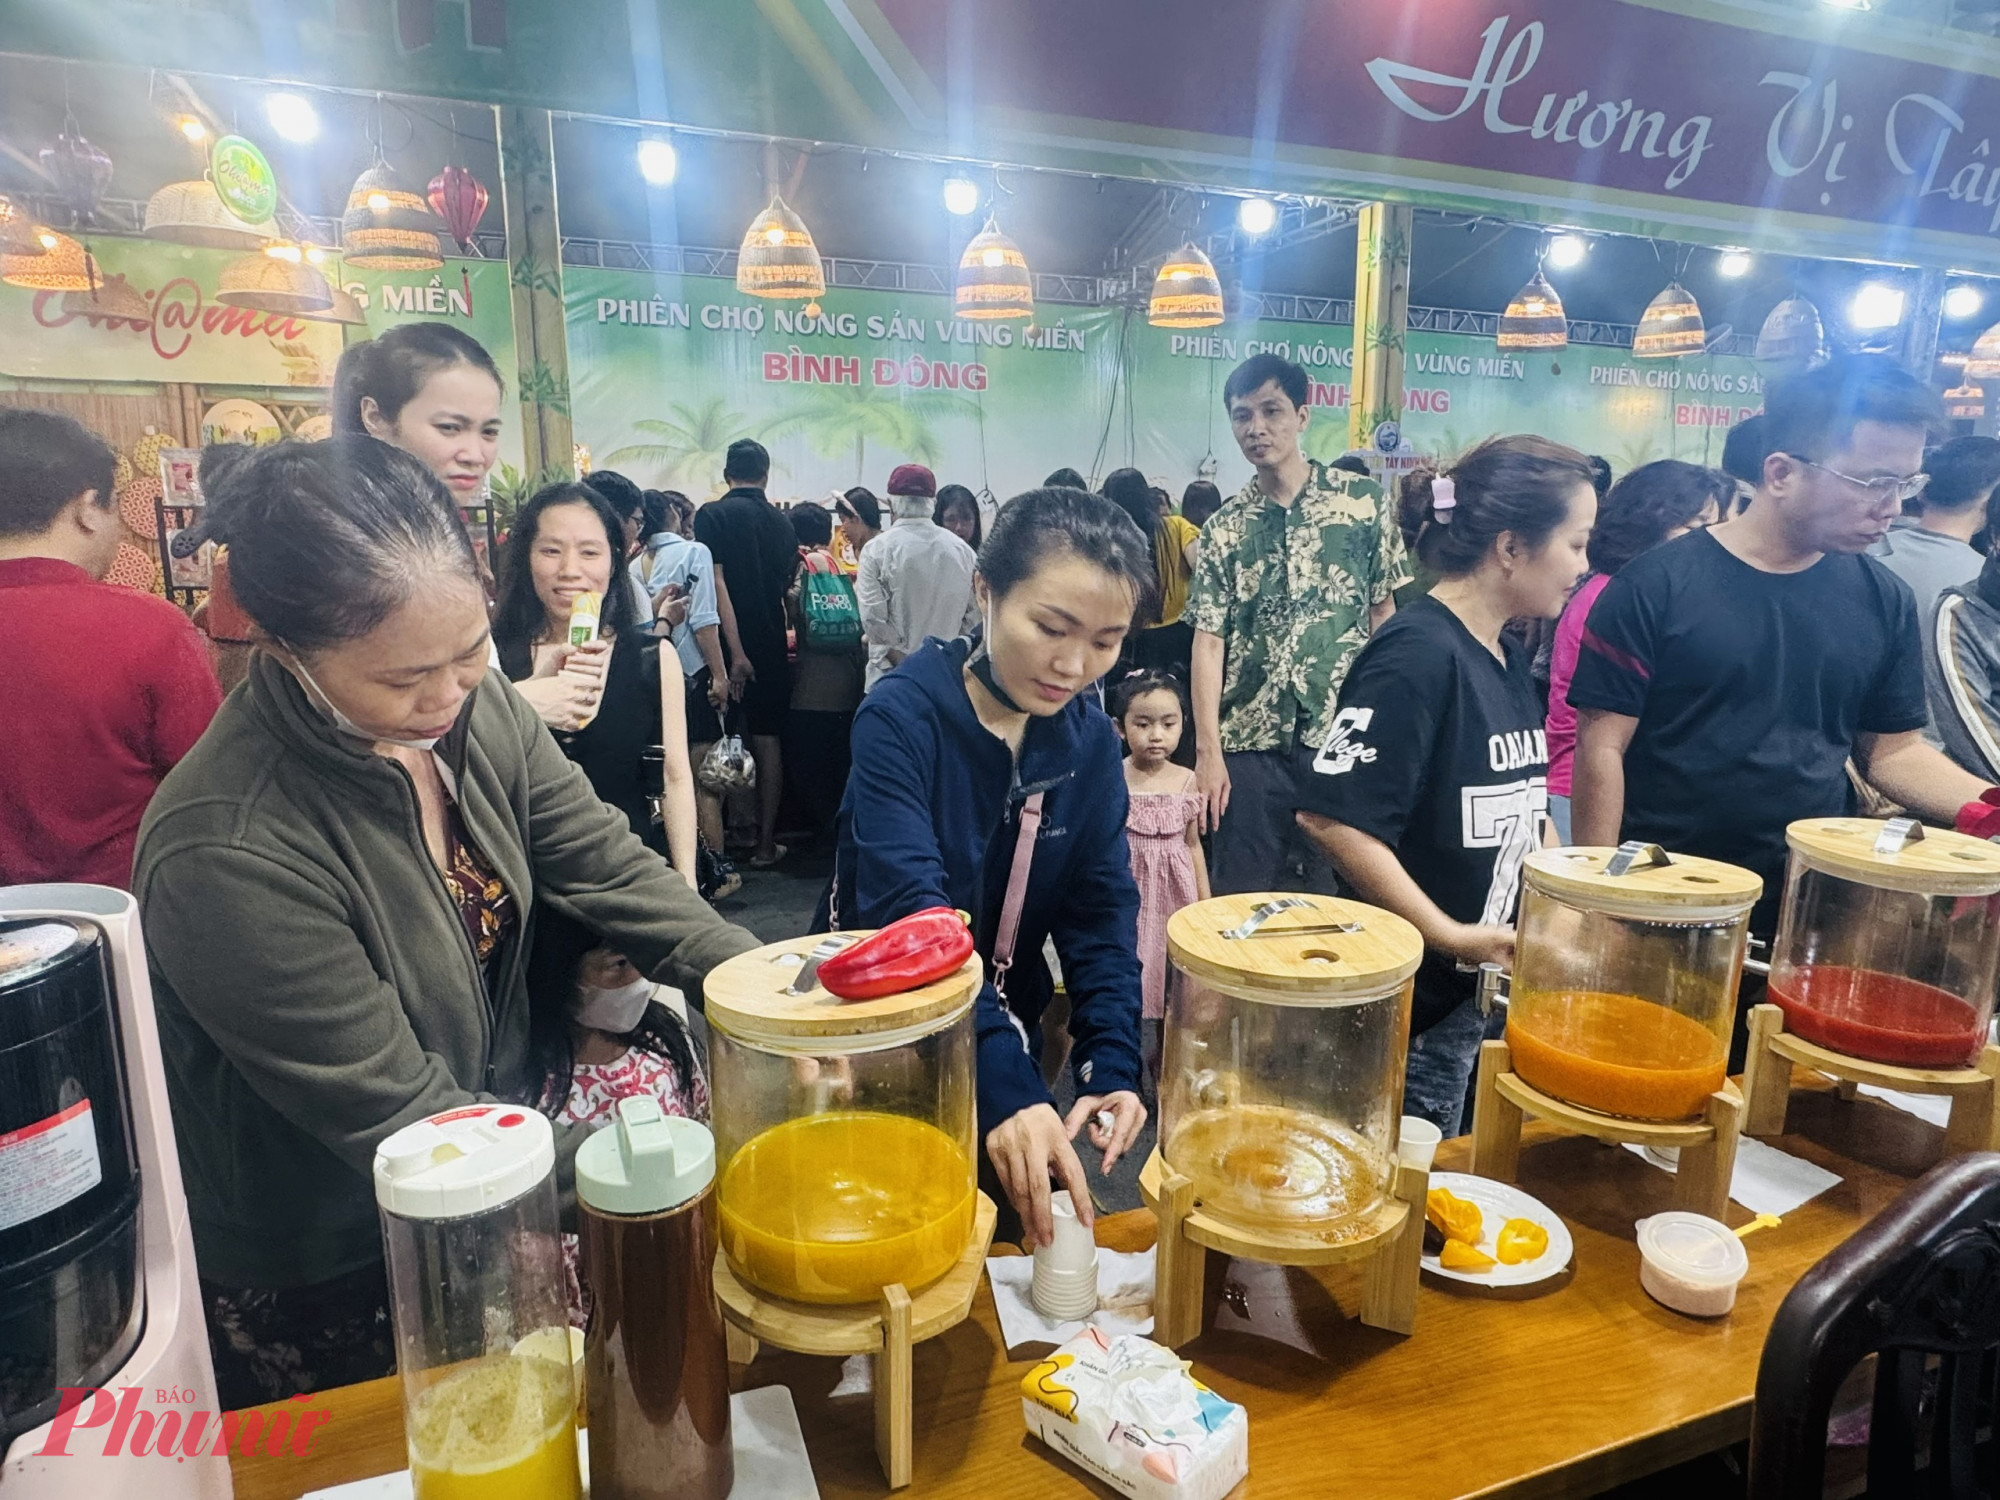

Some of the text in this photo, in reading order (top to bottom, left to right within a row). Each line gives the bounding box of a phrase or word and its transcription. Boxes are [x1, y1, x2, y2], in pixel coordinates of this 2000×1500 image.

[1364, 15, 1714, 190] Hương
[1757, 71, 1854, 206] Vị
[381, 274, 472, 317] MIỀN
[597, 293, 690, 328] PHIÊN
[700, 303, 765, 338] CHỢ
[774, 303, 858, 337] NÔNG
[867, 309, 926, 343] SẢN
[1021, 317, 1085, 352] MIỀN
[1170, 331, 1237, 360] PHIÊN
[1415, 347, 1471, 375] VÙNG
[762, 345, 988, 391] BÌNH ĐÔNG
[1590, 363, 1641, 387] PHIÊN
[1685, 368, 1733, 392] NÔNG
[1675, 398, 1732, 428] BÌNH
